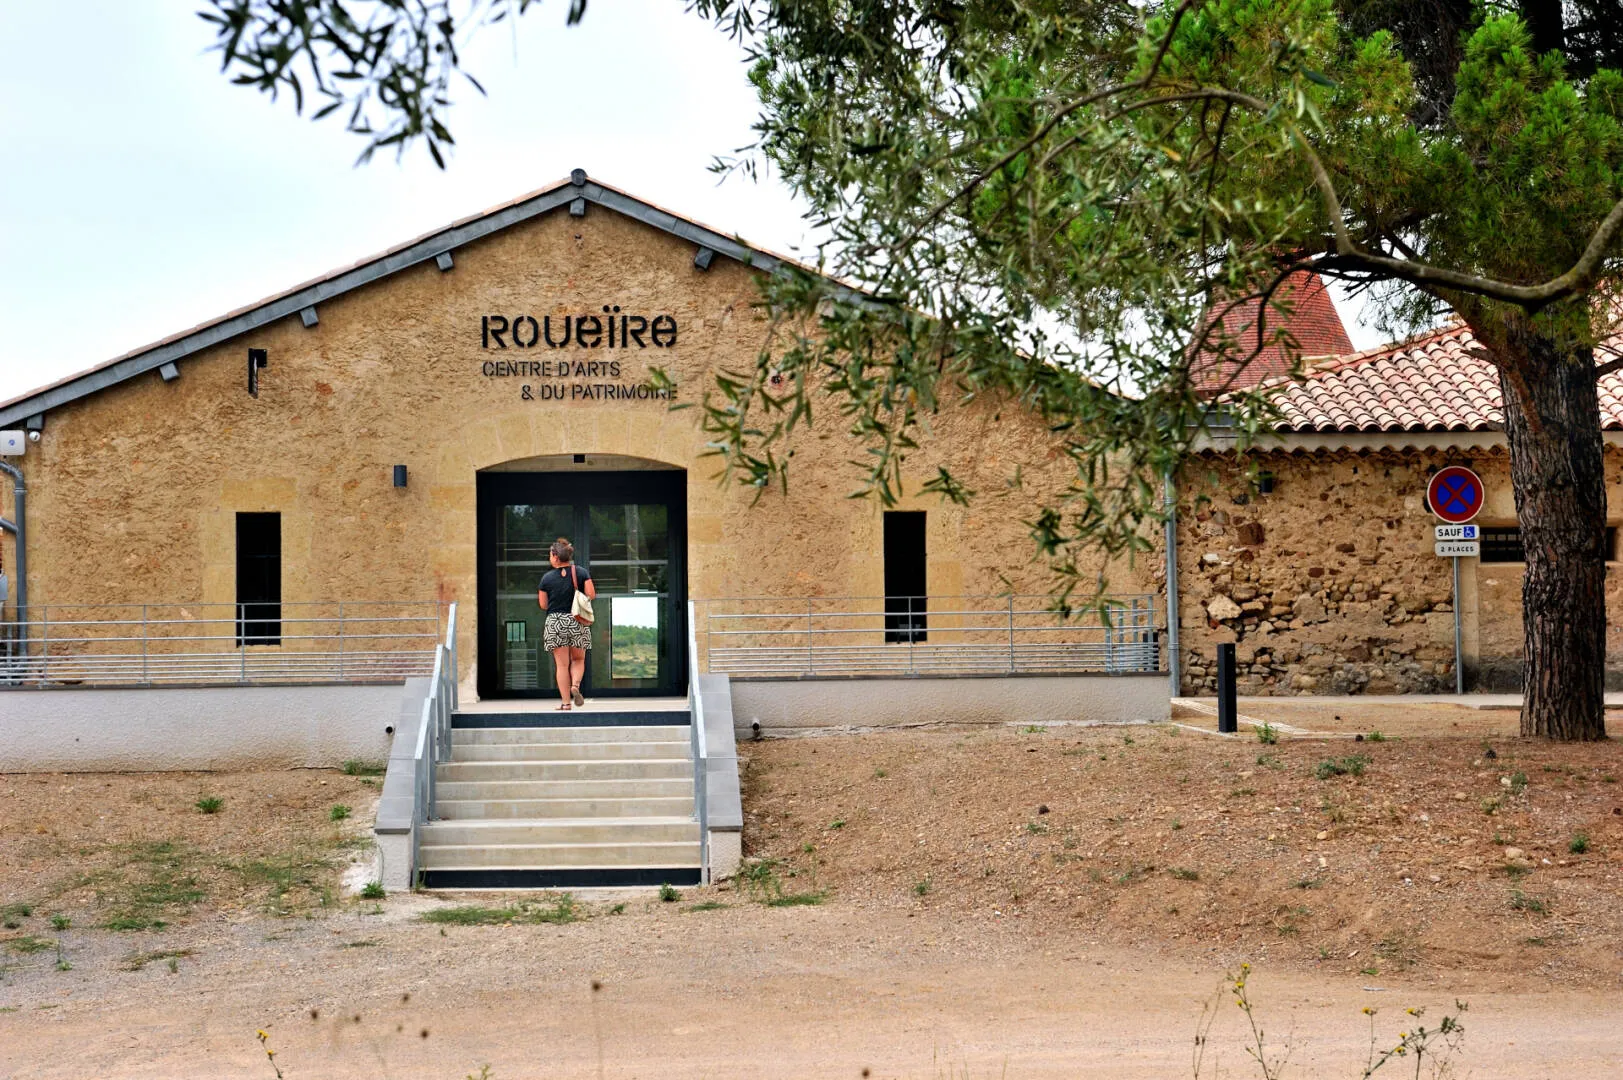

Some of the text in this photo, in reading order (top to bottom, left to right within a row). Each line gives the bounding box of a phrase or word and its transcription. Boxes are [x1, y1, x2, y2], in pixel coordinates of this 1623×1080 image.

[482, 360, 621, 377] CENTRE D'ARTS
[521, 384, 535, 400] &
[541, 384, 565, 400] DU
[1438, 528, 1462, 537] SAUF
